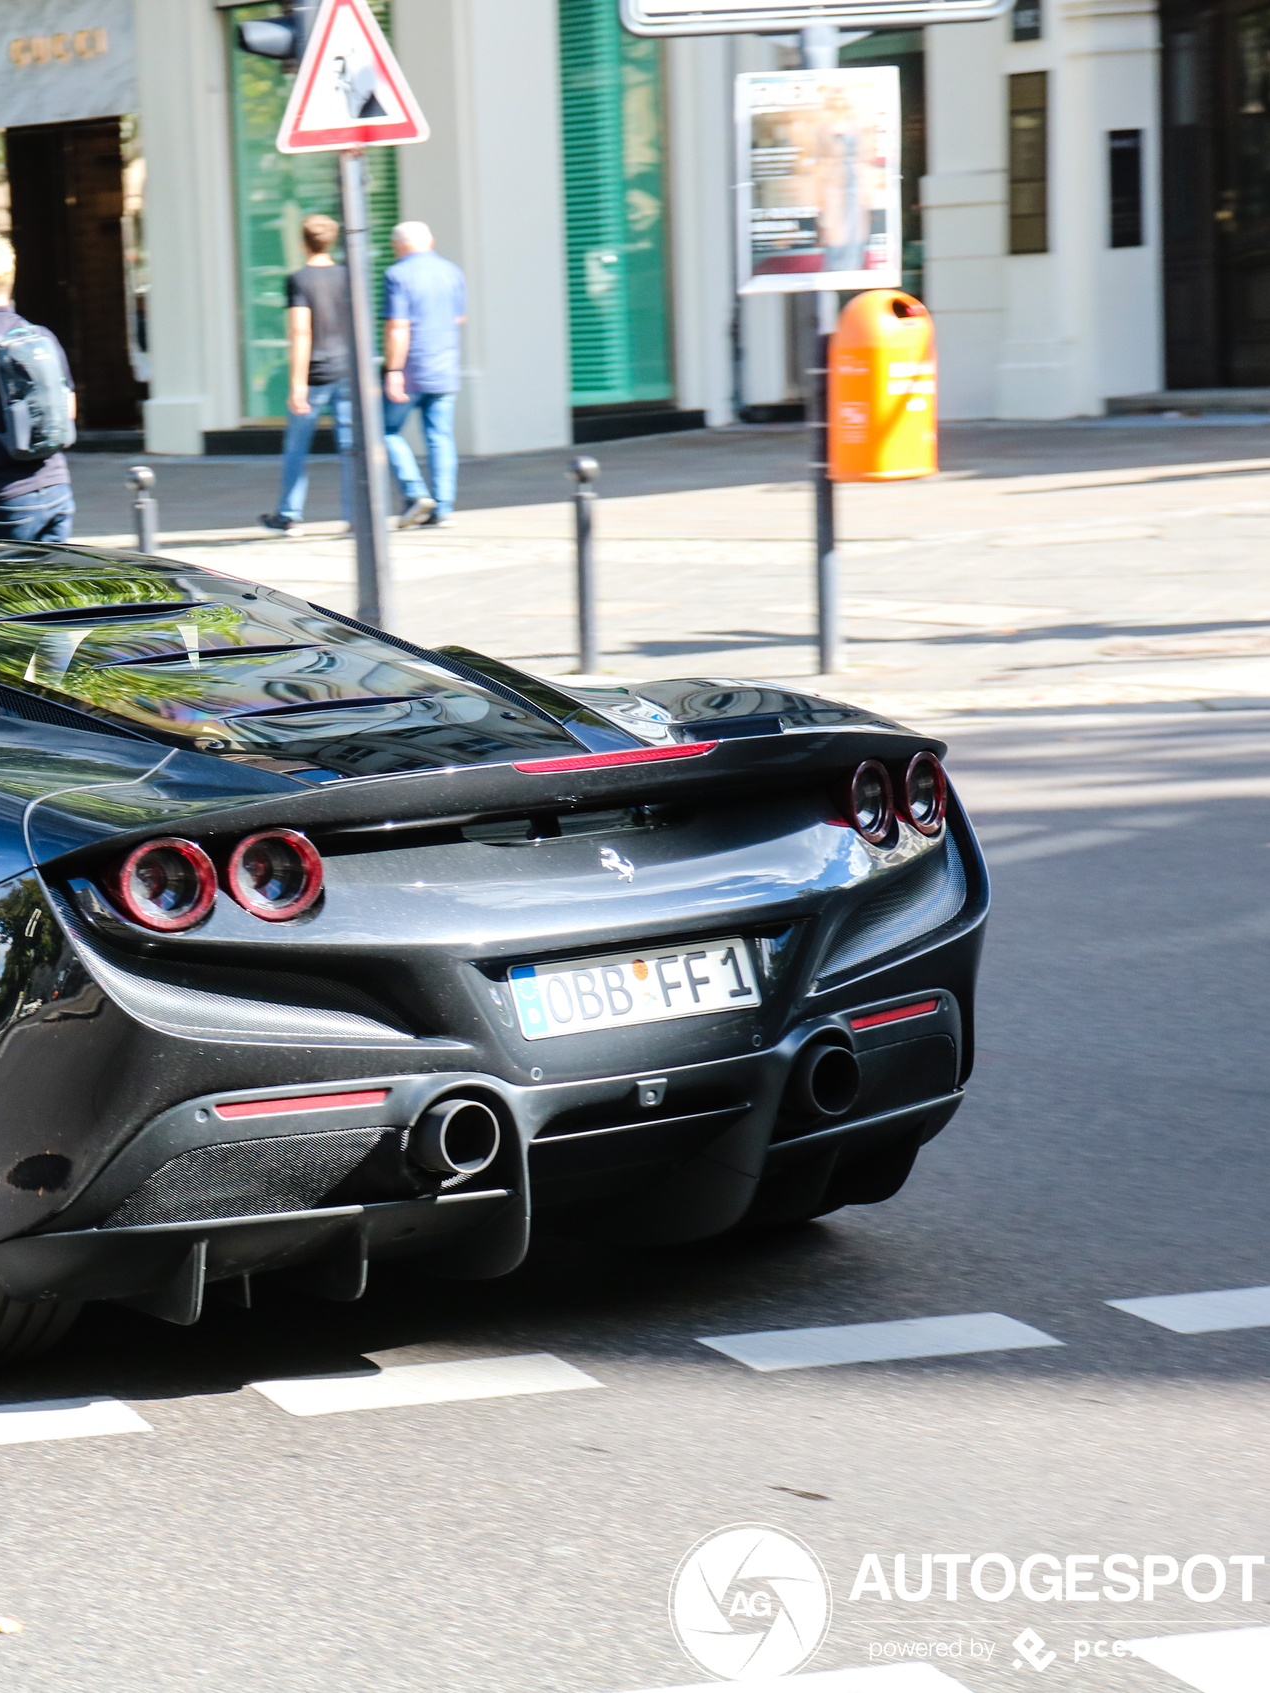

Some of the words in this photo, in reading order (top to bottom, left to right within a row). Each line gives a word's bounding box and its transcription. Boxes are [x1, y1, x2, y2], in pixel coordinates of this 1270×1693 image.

[8, 26, 109, 66] GUCCI
[546, 964, 633, 1024] OBB
[654, 950, 710, 1007] FF
[721, 946, 752, 998] 1
